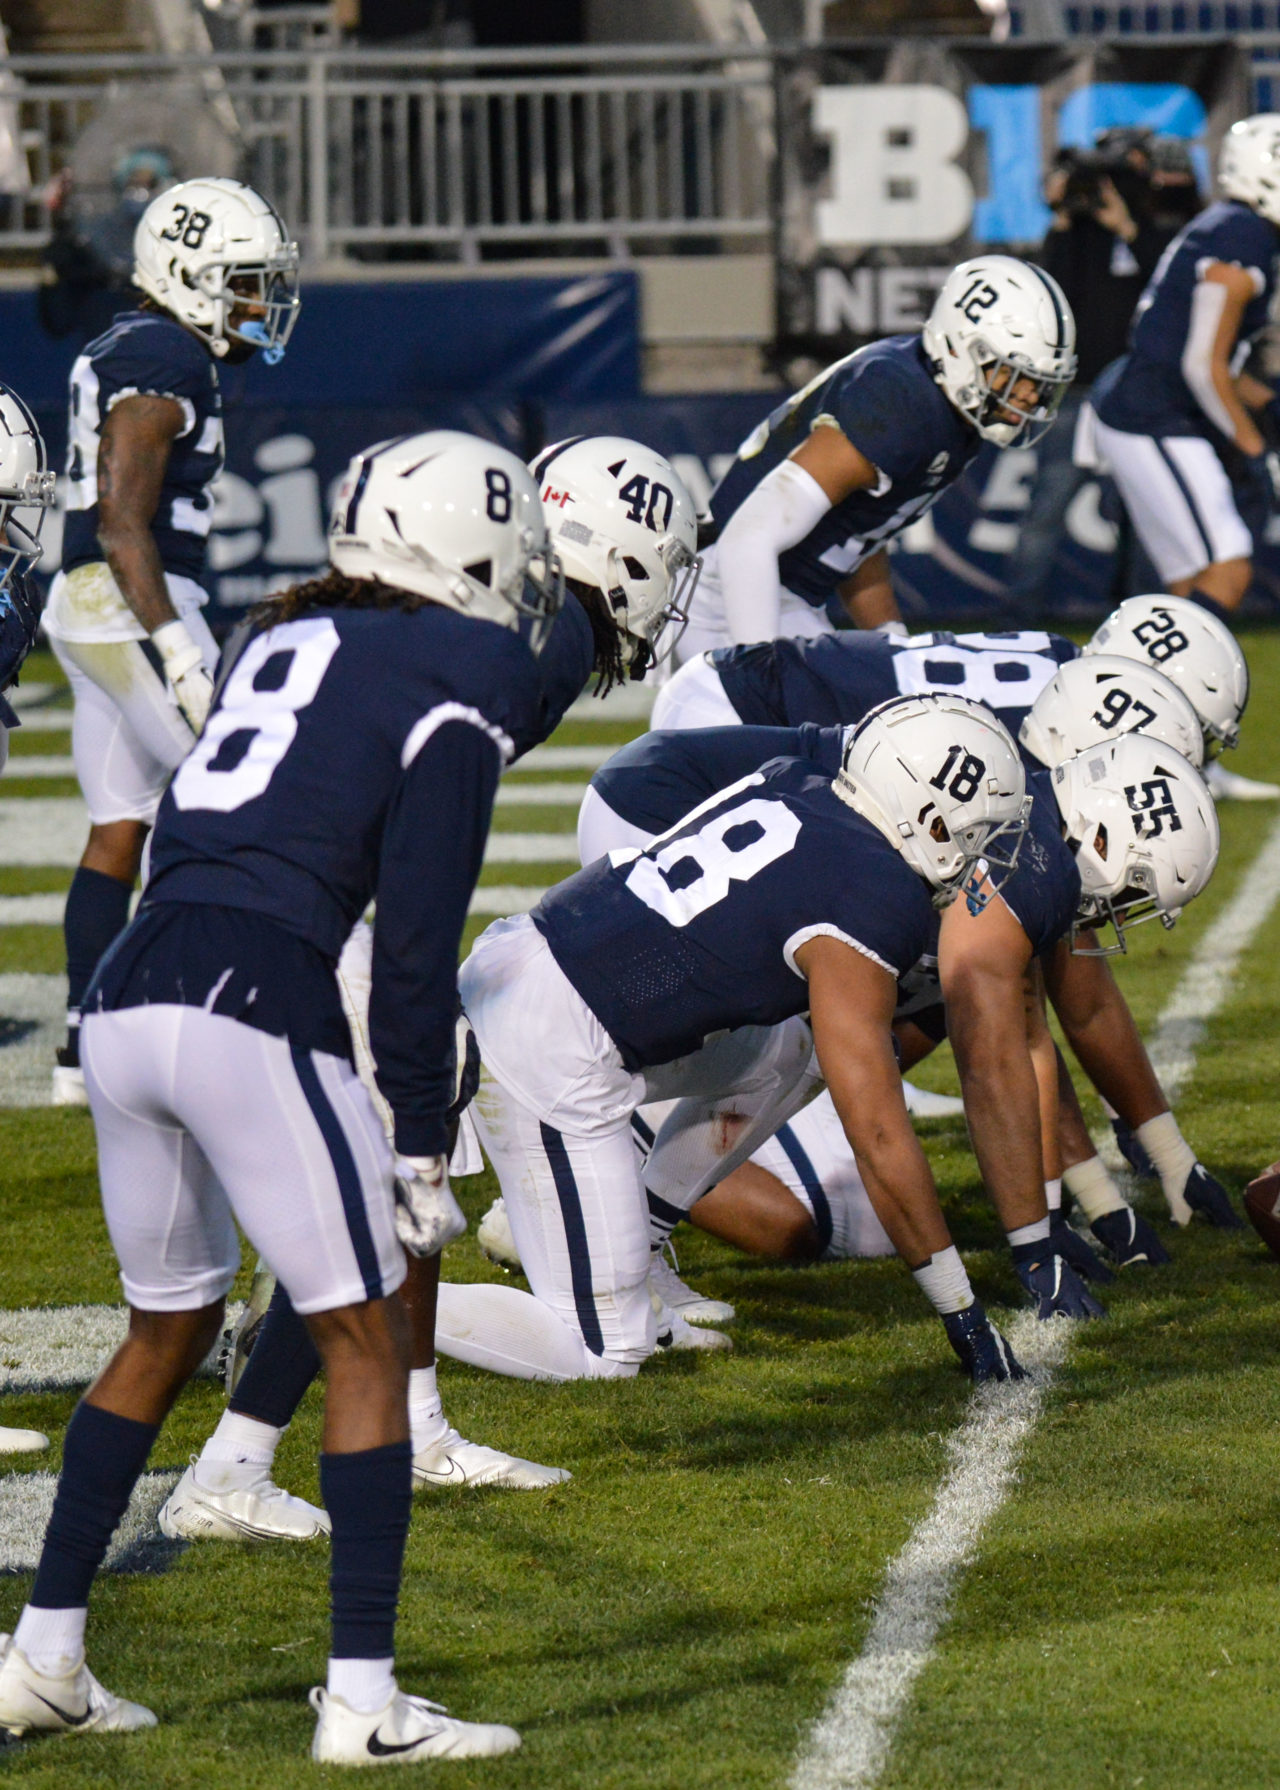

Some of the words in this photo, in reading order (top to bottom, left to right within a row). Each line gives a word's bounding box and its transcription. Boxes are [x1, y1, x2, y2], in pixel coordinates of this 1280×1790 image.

[160, 203, 212, 250] 38
[954, 279, 999, 325] 12
[484, 466, 513, 524] 8
[618, 473, 674, 533] 40
[1131, 611, 1190, 663] 28
[171, 616, 342, 814] 8
[1091, 688, 1157, 732] 97
[929, 744, 986, 803] 18
[1123, 779, 1182, 840] 55
[608, 772, 803, 928] 18
